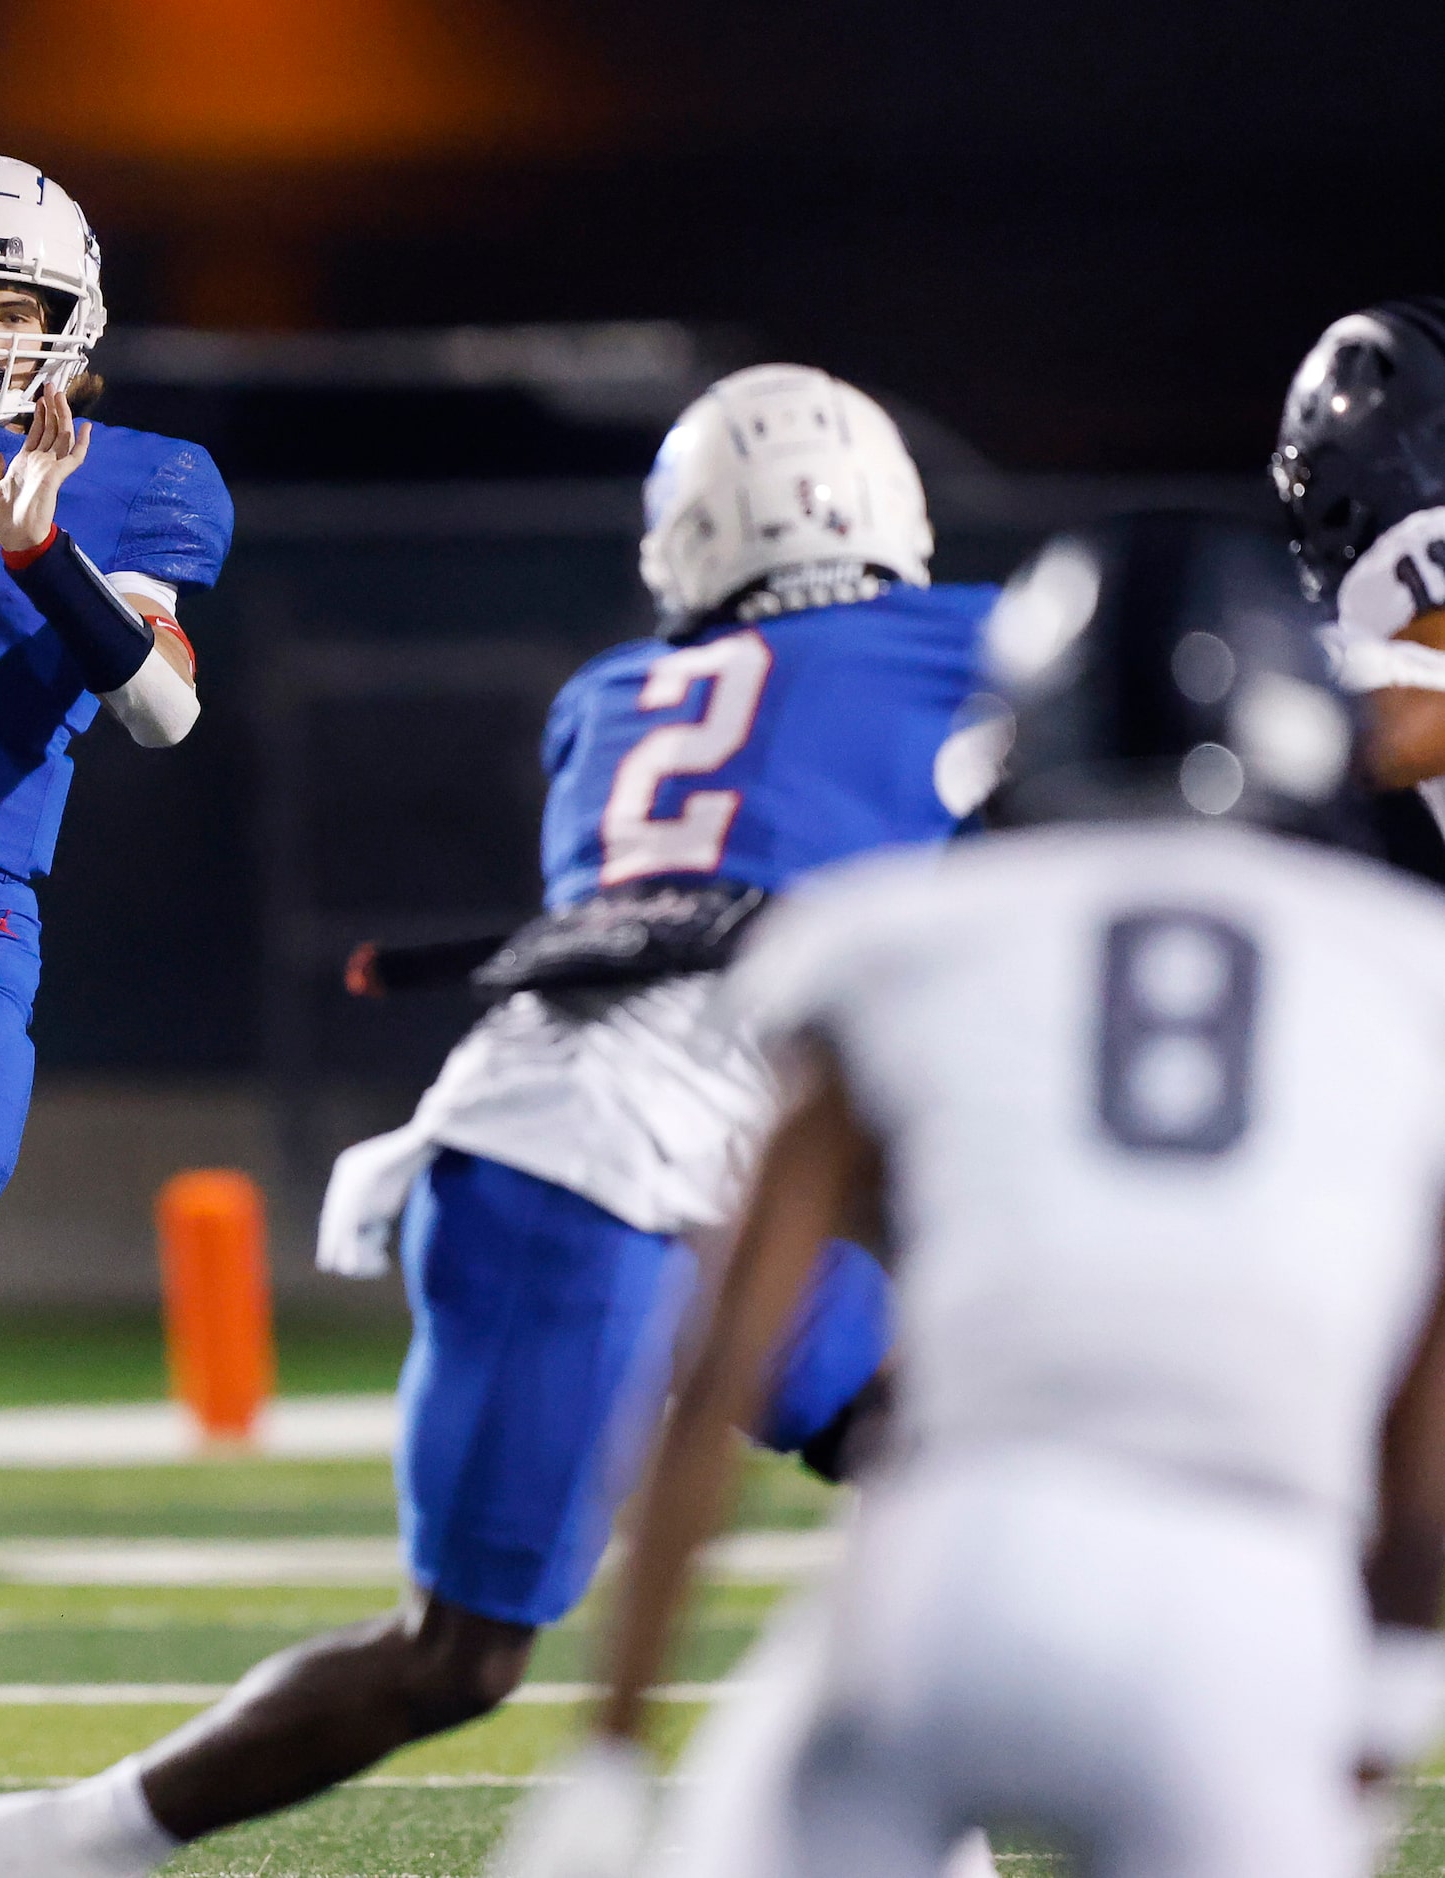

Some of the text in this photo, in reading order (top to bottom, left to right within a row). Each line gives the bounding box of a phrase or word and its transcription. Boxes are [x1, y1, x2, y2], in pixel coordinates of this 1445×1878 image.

[1396, 540, 1445, 615] 1
[599, 627, 773, 887] 2
[1096, 905, 1264, 1160] 8
